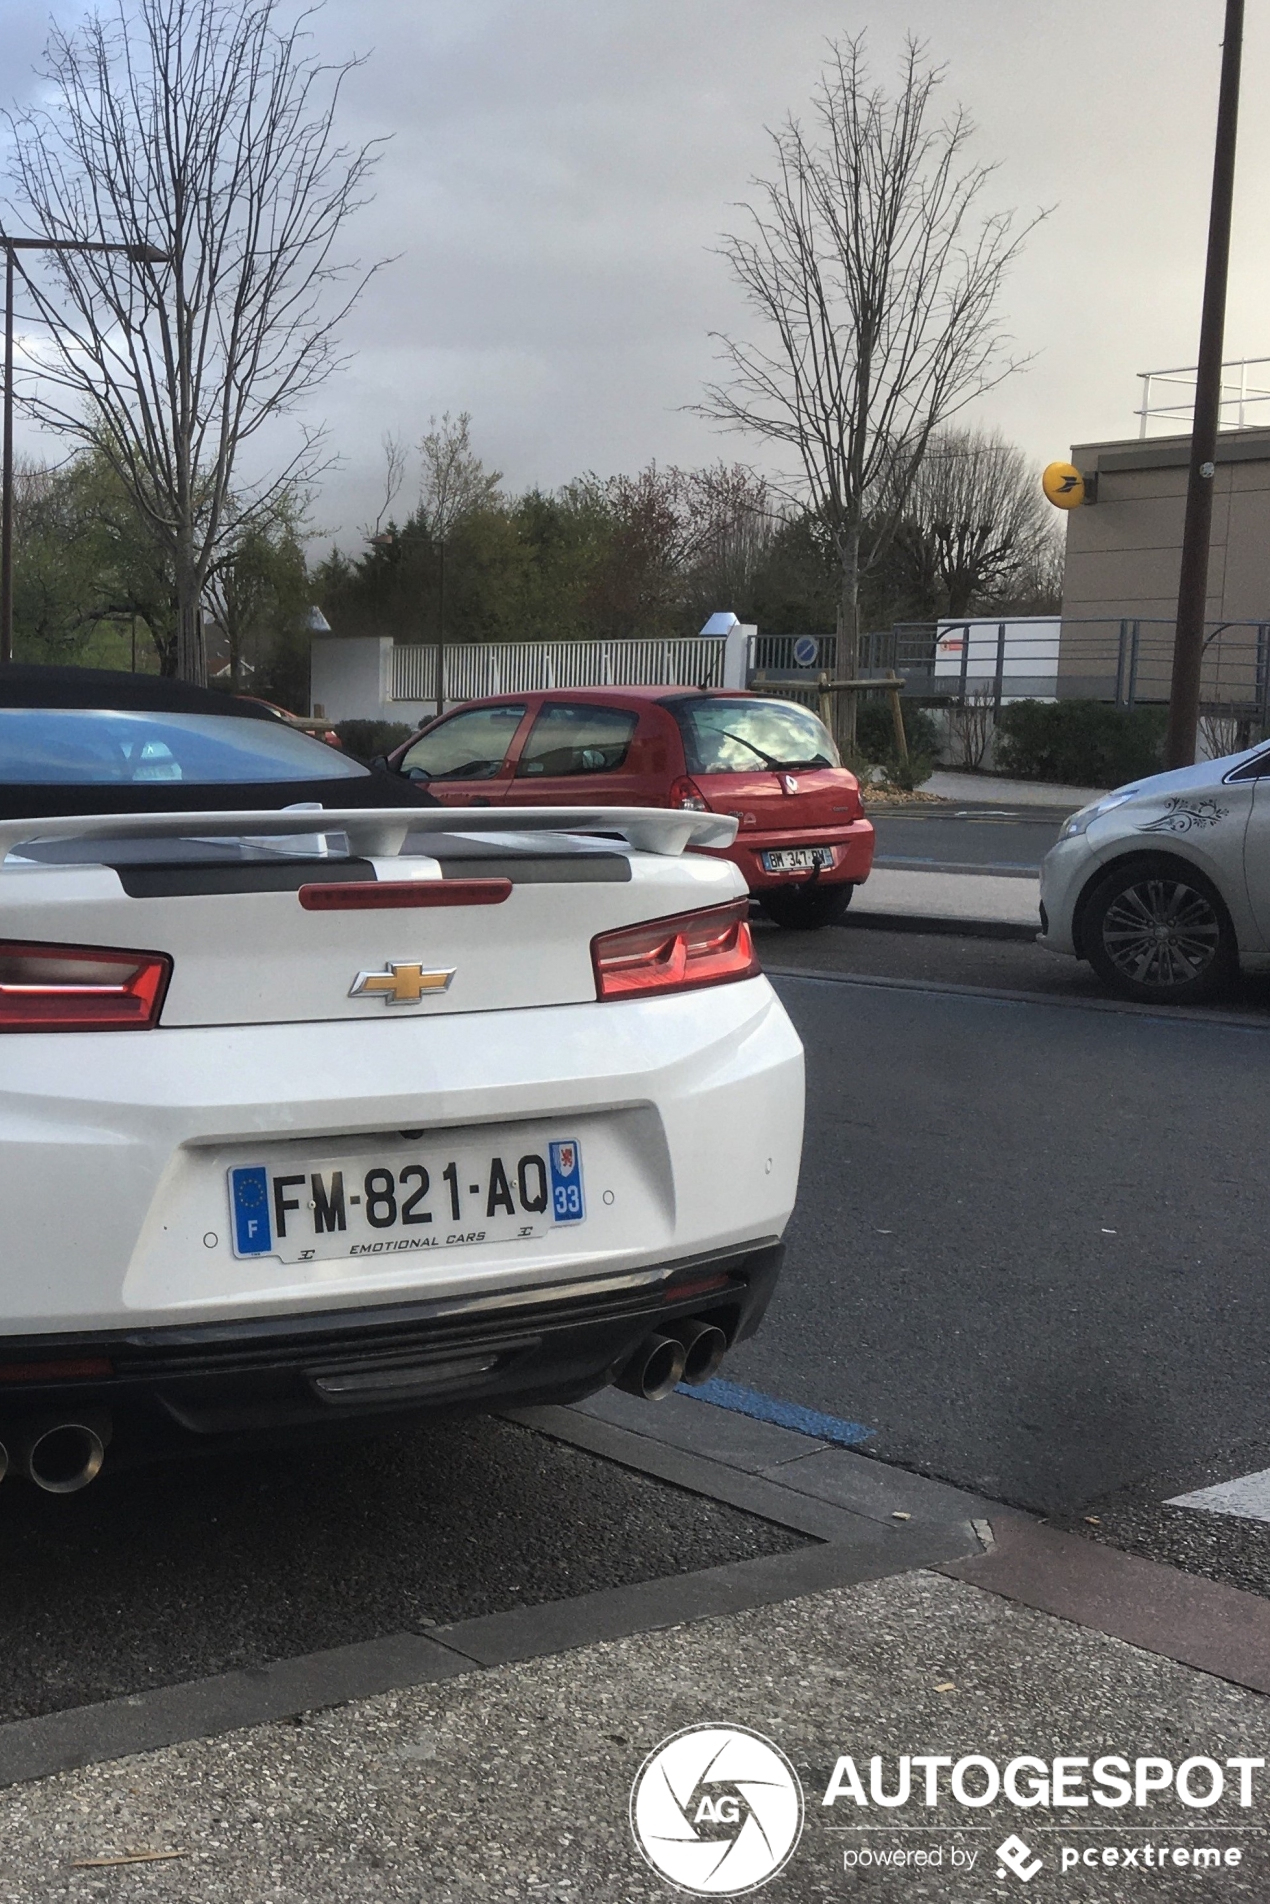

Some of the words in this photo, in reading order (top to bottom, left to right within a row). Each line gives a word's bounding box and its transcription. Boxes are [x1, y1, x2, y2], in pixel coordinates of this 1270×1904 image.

[272, 1154, 549, 1239] FM-821-AQ
[556, 1185, 580, 1214] 33
[247, 1219, 258, 1239] F
[349, 1236, 439, 1255] EMOTIONAL
[446, 1231, 486, 1246] CARS
